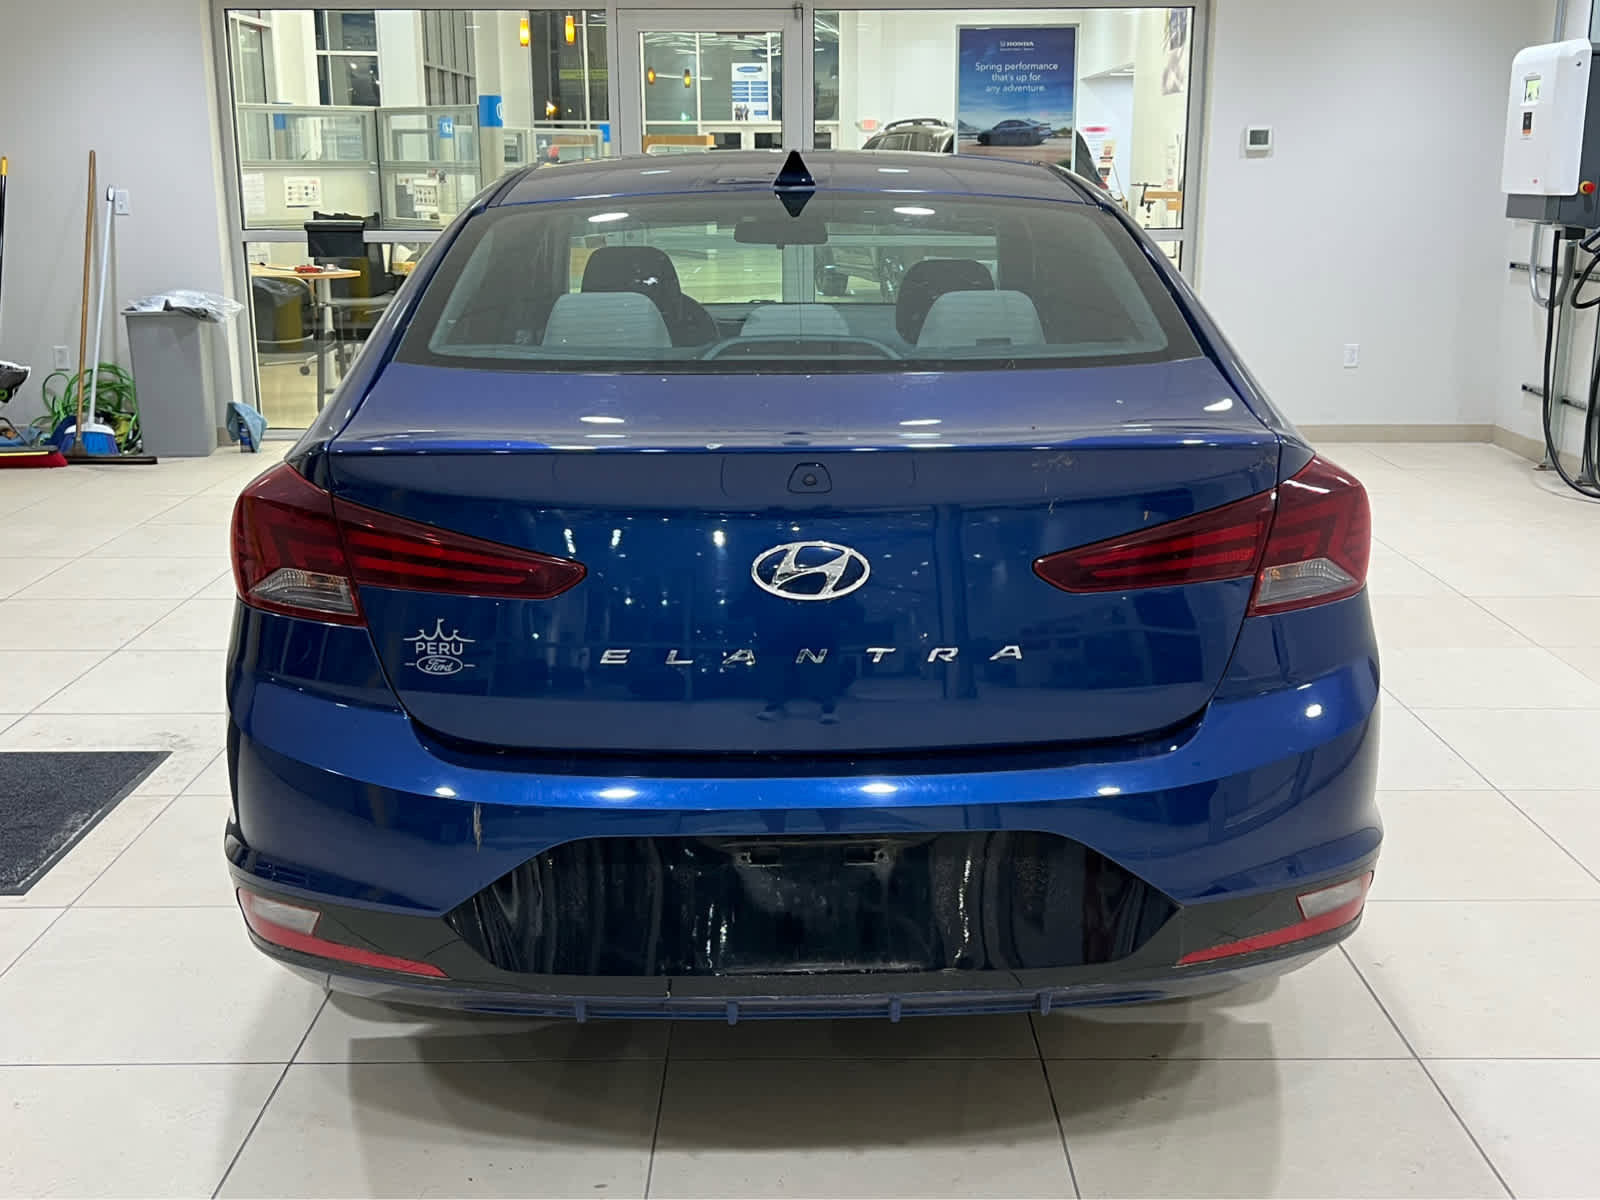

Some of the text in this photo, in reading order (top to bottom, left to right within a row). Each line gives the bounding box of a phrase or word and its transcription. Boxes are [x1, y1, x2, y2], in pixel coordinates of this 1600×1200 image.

[975, 61, 1059, 72] Spring performance
[992, 72, 1041, 83] that's up for
[985, 85, 1000, 94] any
[415, 641, 464, 656] PERU
[600, 645, 1024, 666] ELANTRA
[425, 658, 453, 672] Ford
